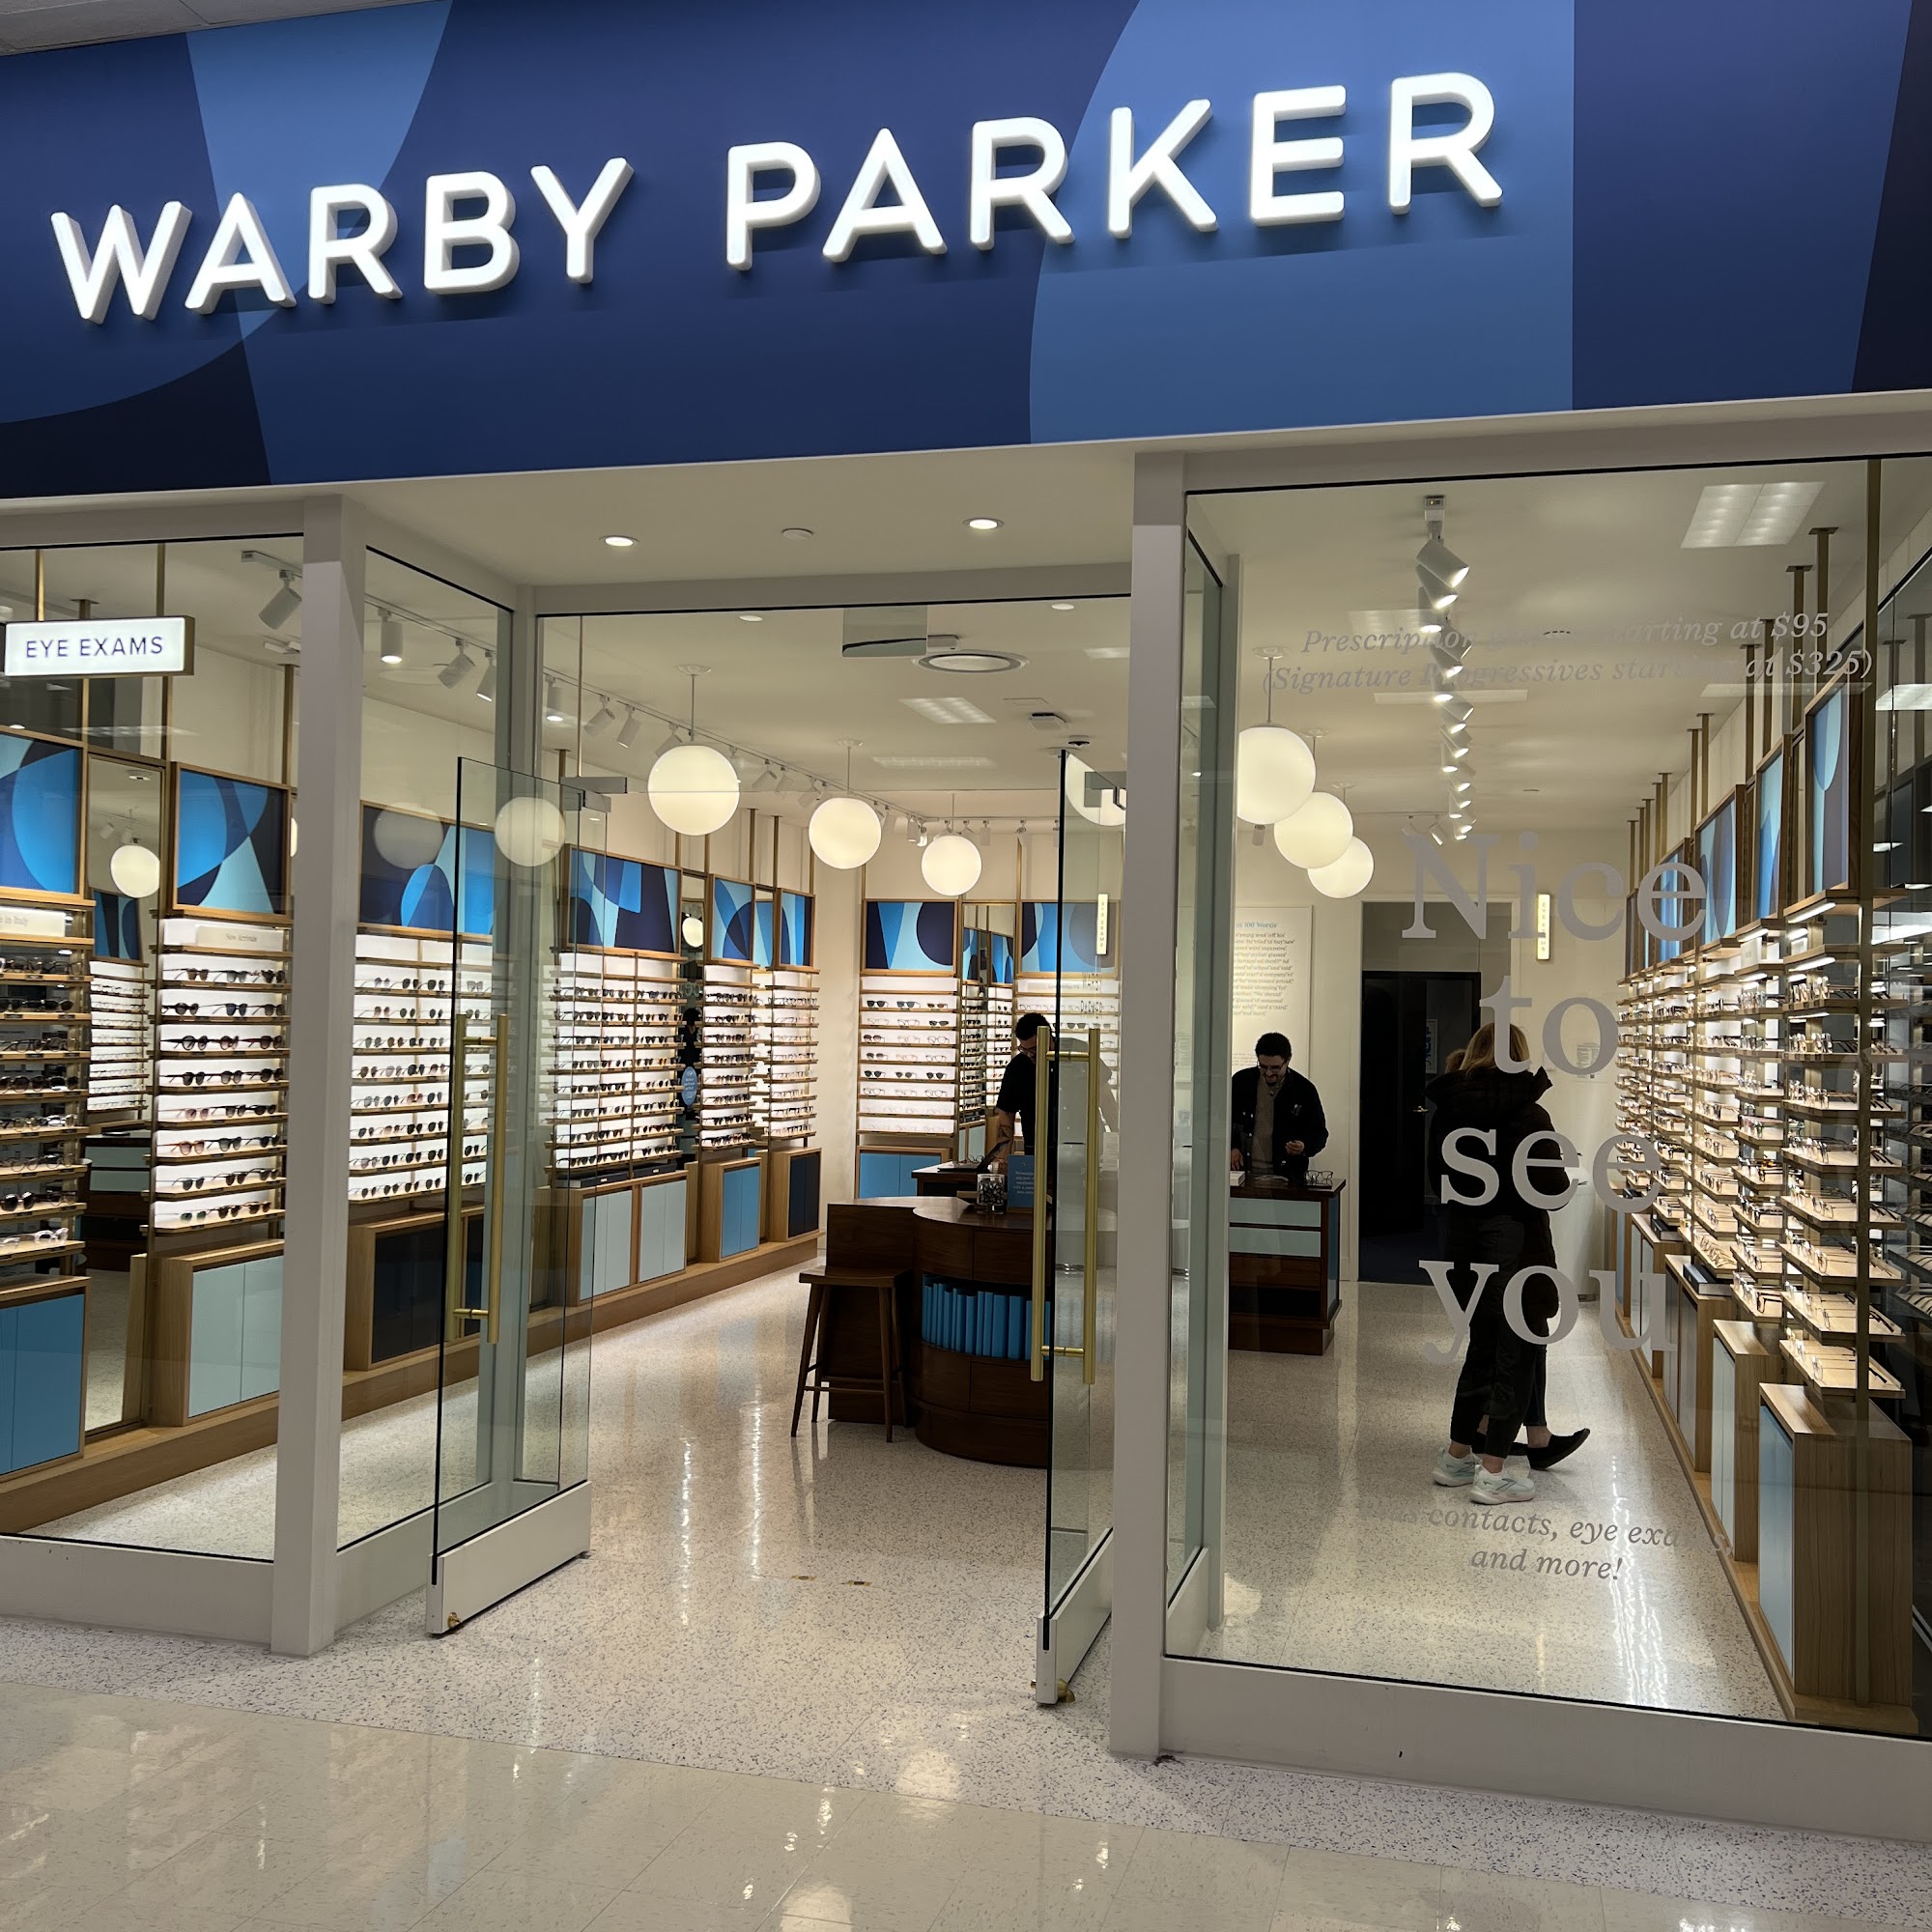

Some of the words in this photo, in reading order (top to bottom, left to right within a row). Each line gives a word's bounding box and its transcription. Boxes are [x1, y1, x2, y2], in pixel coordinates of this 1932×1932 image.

[51, 156, 634, 326] WARBY
[726, 71, 1504, 271] PARKER
[26, 639, 70, 659] EYE
[79, 636, 164, 657] EXAMS
[1729, 618, 1763, 639] at
[1771, 611, 1830, 640] $95
[1263, 666, 1411, 695] (Signature
[1419, 658, 1603, 689] Pogressives
[1745, 654, 1775, 677] at
[1785, 648, 1873, 680] $325)
[1402, 831, 1707, 942] Nice
[1479, 975, 1620, 1076] to
[1440, 1126, 1662, 1214] see
[1418, 1259, 1679, 1366] you
[1428, 1506, 1558, 1543] contacts,
[1569, 1520, 1619, 1546] eye
[1470, 1548, 1528, 1572] and
[1536, 1554, 1623, 1580] more!
